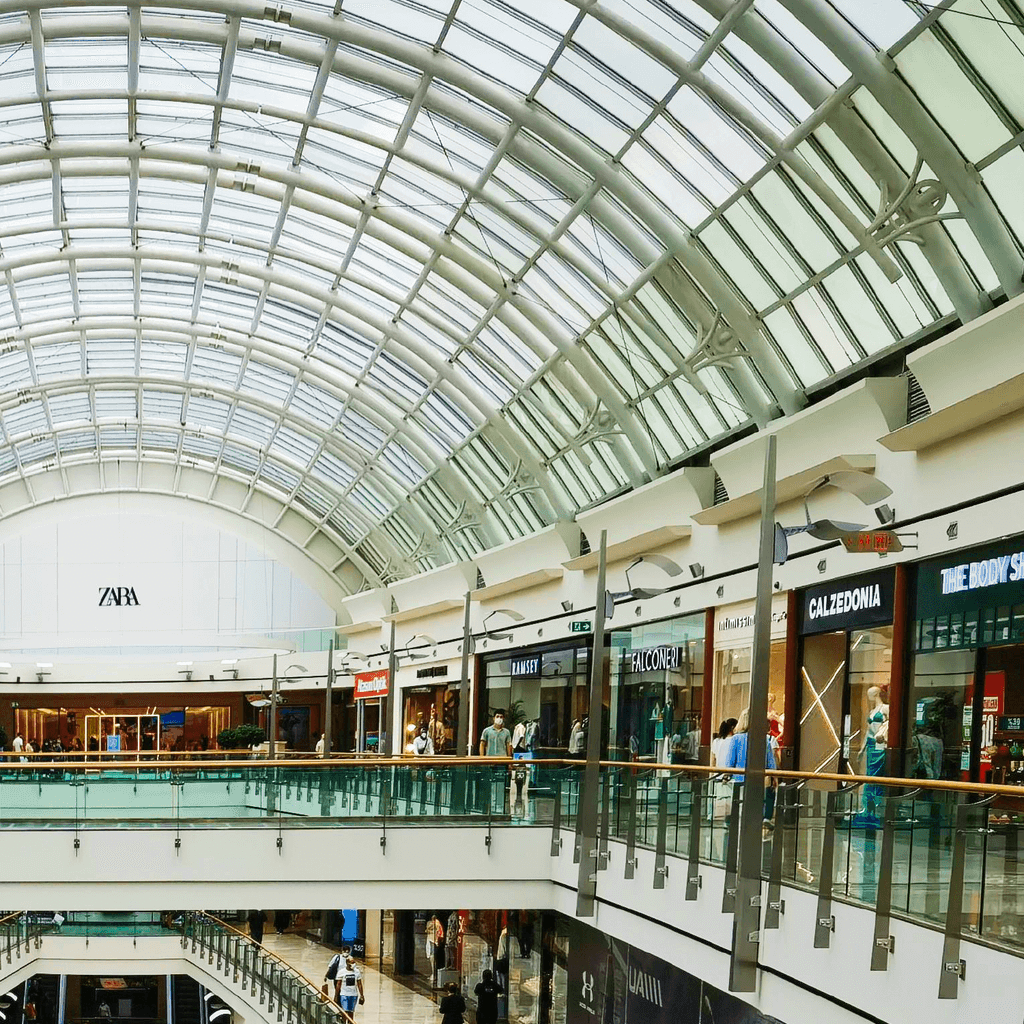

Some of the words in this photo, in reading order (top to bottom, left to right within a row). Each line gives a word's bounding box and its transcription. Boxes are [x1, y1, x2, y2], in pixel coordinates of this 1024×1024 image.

[940, 564, 970, 595] THE
[969, 555, 1012, 589] BODY
[98, 586, 141, 606] ZARA
[808, 584, 881, 620] CALZEDONIA
[511, 658, 539, 676] RAMSEY
[631, 647, 679, 673] FALCONERI
